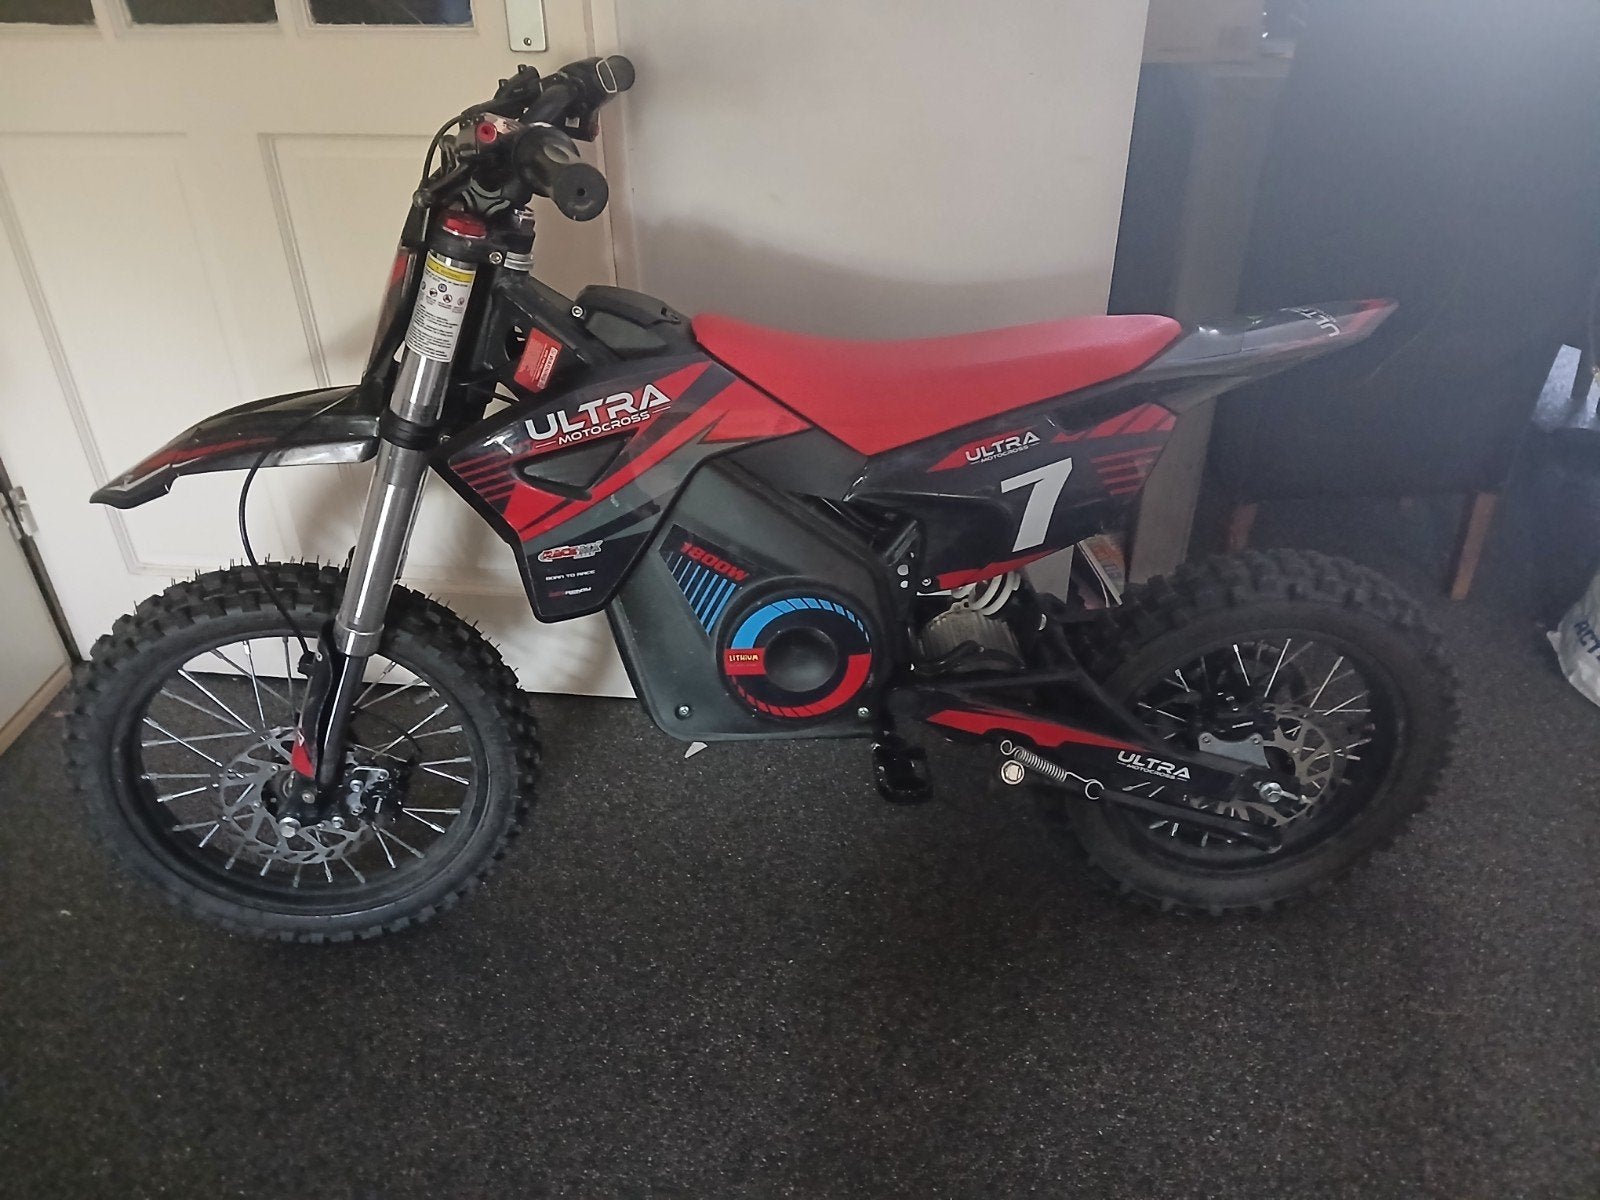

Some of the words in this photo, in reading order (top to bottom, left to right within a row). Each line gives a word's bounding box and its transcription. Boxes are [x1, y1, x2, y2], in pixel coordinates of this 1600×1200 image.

[525, 384, 671, 441] ULTRA
[559, 410, 650, 445] MOTOCROSS
[965, 431, 1040, 461] ULTRA
[981, 445, 1029, 463] MOTOCROSS
[1000, 457, 1073, 553] 7
[729, 654, 759, 662] LITHIUM
[1117, 750, 1191, 779] ULTRA
[1126, 763, 1176, 781] MOTOCROSS
